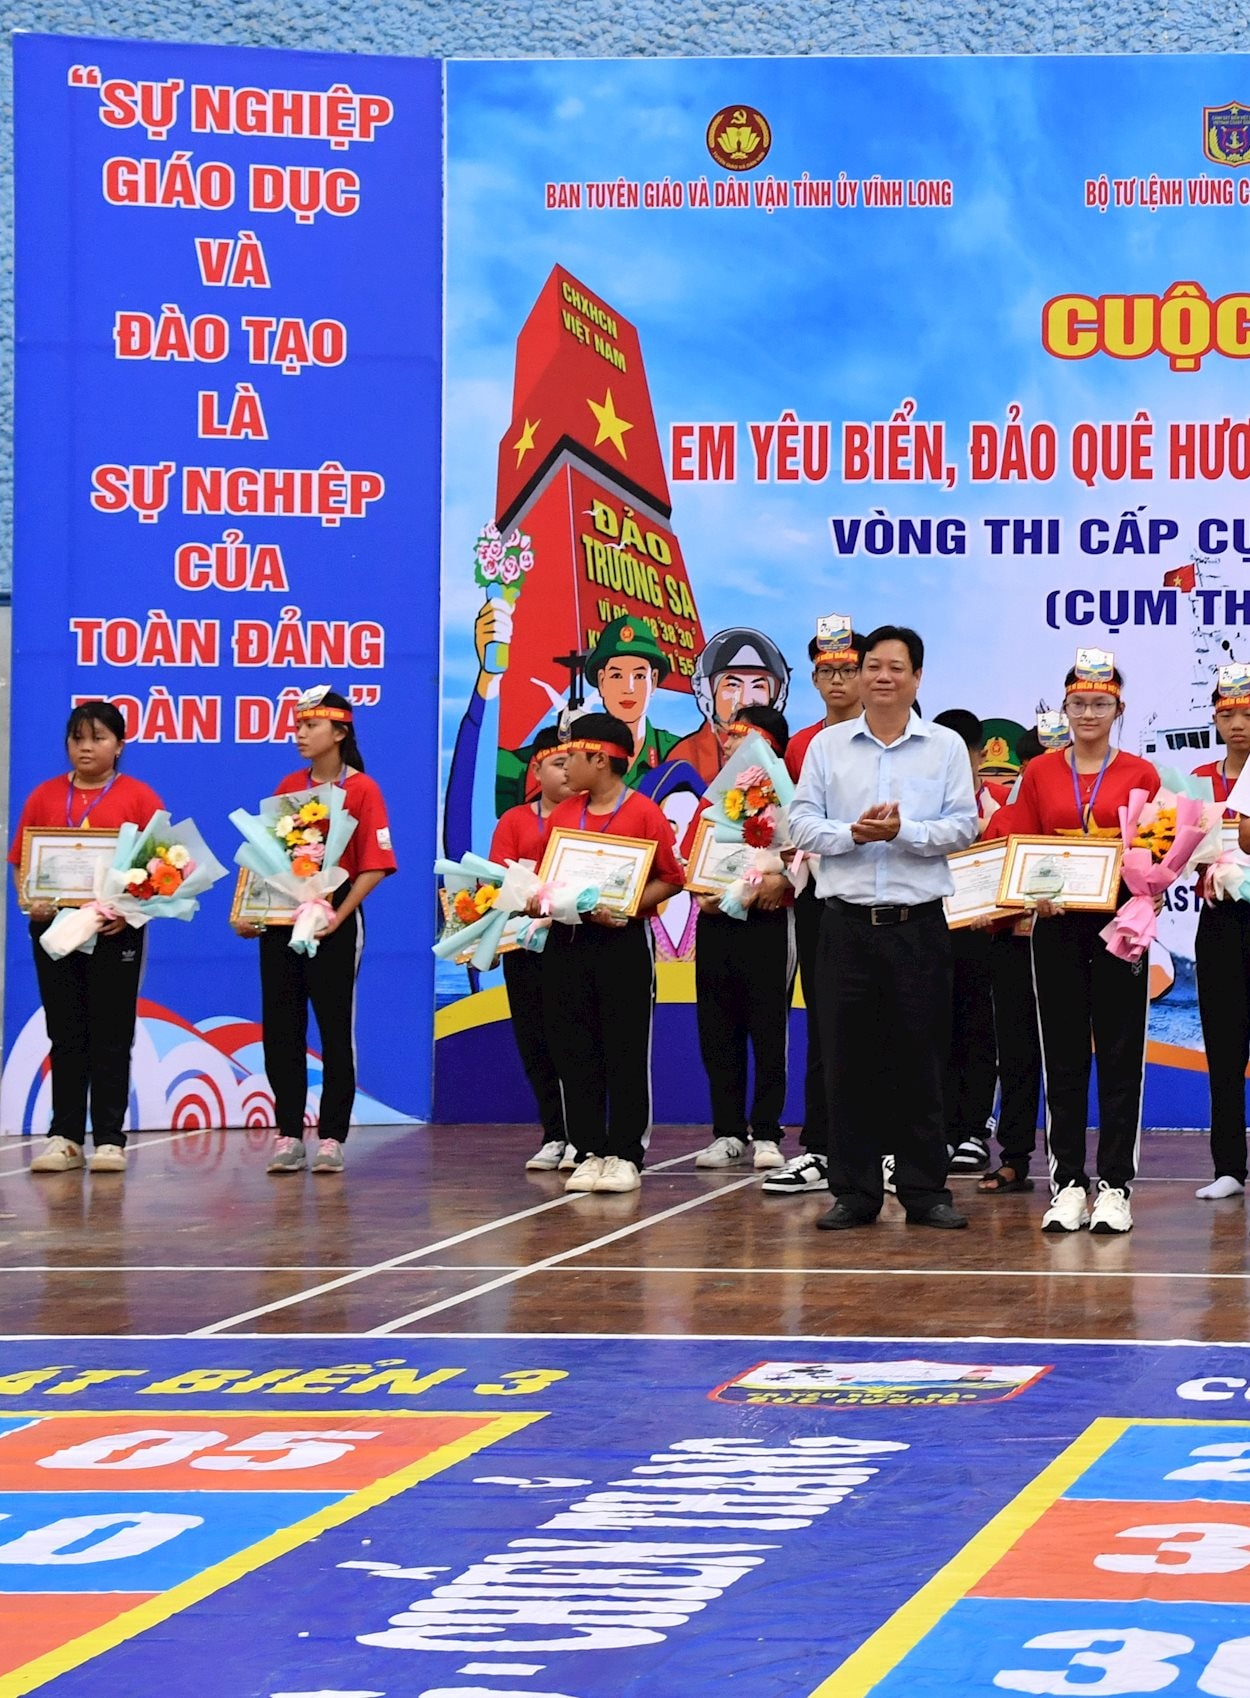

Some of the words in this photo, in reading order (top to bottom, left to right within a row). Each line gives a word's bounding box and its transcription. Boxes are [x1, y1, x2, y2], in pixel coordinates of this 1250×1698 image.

[193, 86, 393, 149] NGHIỆP
[104, 152, 234, 209] GIÁO
[250, 166, 359, 223] DỤC
[546, 183, 581, 208] BAN
[586, 178, 638, 208] TUYÊN
[644, 177, 683, 208] GIÁO
[689, 177, 711, 207] VÀ
[715, 178, 749, 207] DÂN
[755, 178, 788, 212] VẬN
[793, 174, 831, 207] TỈNH
[837, 173, 861, 207] ỦY
[864, 176, 902, 206] VĨNH
[907, 180, 953, 206] LONG
[1086, 175, 1110, 211] BỘ
[1113, 177, 1137, 206] TƯ
[1140, 175, 1183, 211] LỆNH
[1188, 174, 1233, 205] VÙNG
[197, 231, 270, 287] VÀ
[114, 304, 229, 362] ĐÀO
[244, 316, 347, 374] TẠO
[562, 281, 618, 340] CHXHCN
[561, 308, 591, 344] VIỆT
[594, 336, 628, 374] NAM
[198, 384, 268, 440] LÀ
[671, 424, 736, 482] EM
[749, 411, 830, 482] YÊU
[843, 399, 957, 488] BIỂN,
[969, 403, 1057, 482] ĐẢO
[1071, 410, 1155, 488] QUÊ
[92, 461, 175, 522] SỰ
[185, 463, 385, 527] NGHIỆP
[591, 497, 673, 566] ĐẢO
[832, 509, 966, 555] VÒNG
[984, 519, 1060, 555] THI
[1079, 505, 1180, 555] CẤP
[176, 530, 288, 591] CỦA
[665, 574, 698, 622] SA
[1046, 588, 1178, 634] (CỤM
[71, 611, 219, 666] TOÀN
[233, 607, 384, 667] ĐẢNG
[72, 688, 221, 743] OÀN
[237, 686, 379, 743] DÂ”
[134, 1357, 467, 1395] BIỂN
[472, 1369, 570, 1395] 3
[34, 1428, 383, 1471] 05
[0, 1511, 205, 1565] 0
